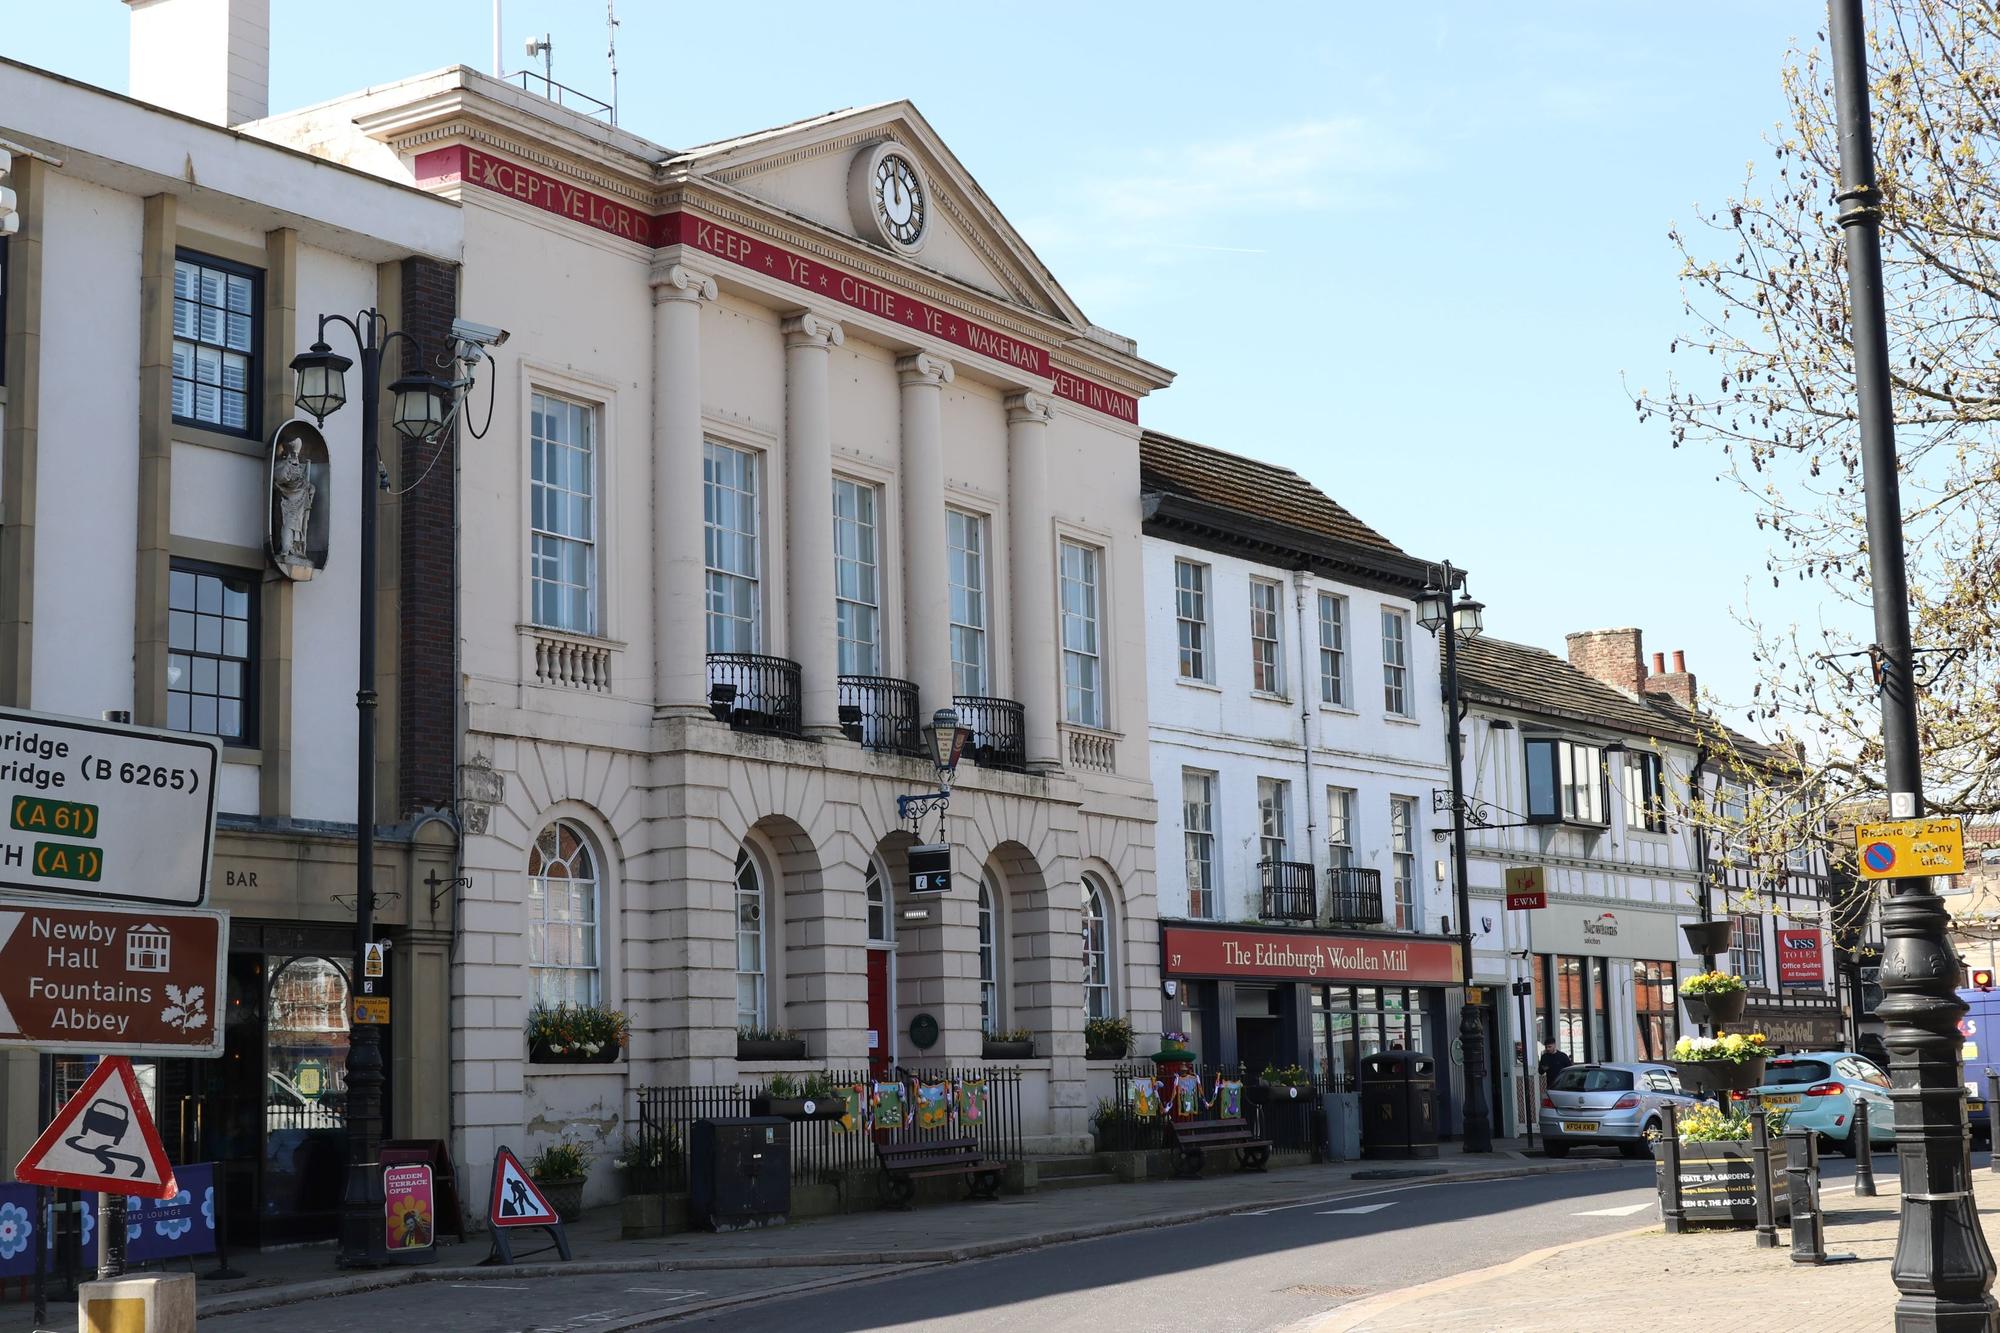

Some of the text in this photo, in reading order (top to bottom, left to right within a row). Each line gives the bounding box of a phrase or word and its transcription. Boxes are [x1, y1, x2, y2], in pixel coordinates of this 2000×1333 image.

[468, 151, 650, 240] EXCEPT YE LORD
[697, 222, 1039, 371] KEEP YE CITTIE YE WAKEMAN
[1052, 371, 1133, 420] KETH IN VAIN
[0, 731, 69, 760] ridge
[81, 754, 199, 795] (B 6265)
[1895, 794, 1909, 815] 9
[16, 800, 94, 834] (A 61)
[38, 847, 69, 873] (A
[77, 851, 98, 878] 1)
[226, 870, 258, 887] BAR
[1514, 897, 1538, 906] EWM
[32, 917, 117, 946] Newby
[47, 946, 99, 969] Hall
[1171, 955, 1181, 967] 37
[1222, 941, 1408, 975] The Edinburgh Woollen Mill
[1784, 951, 1817, 959] TO LET
[29, 977, 152, 1003] Fountains
[51, 1007, 130, 1035] Abbey
[388, 1172, 423, 1180] GARDEN
[389, 1179, 428, 1187] TERRACE
[1718, 1173, 1750, 1181] GARDENS
[147, 1209, 181, 1219] LOUNGE
[1708, 1199, 1722, 1207] THE
